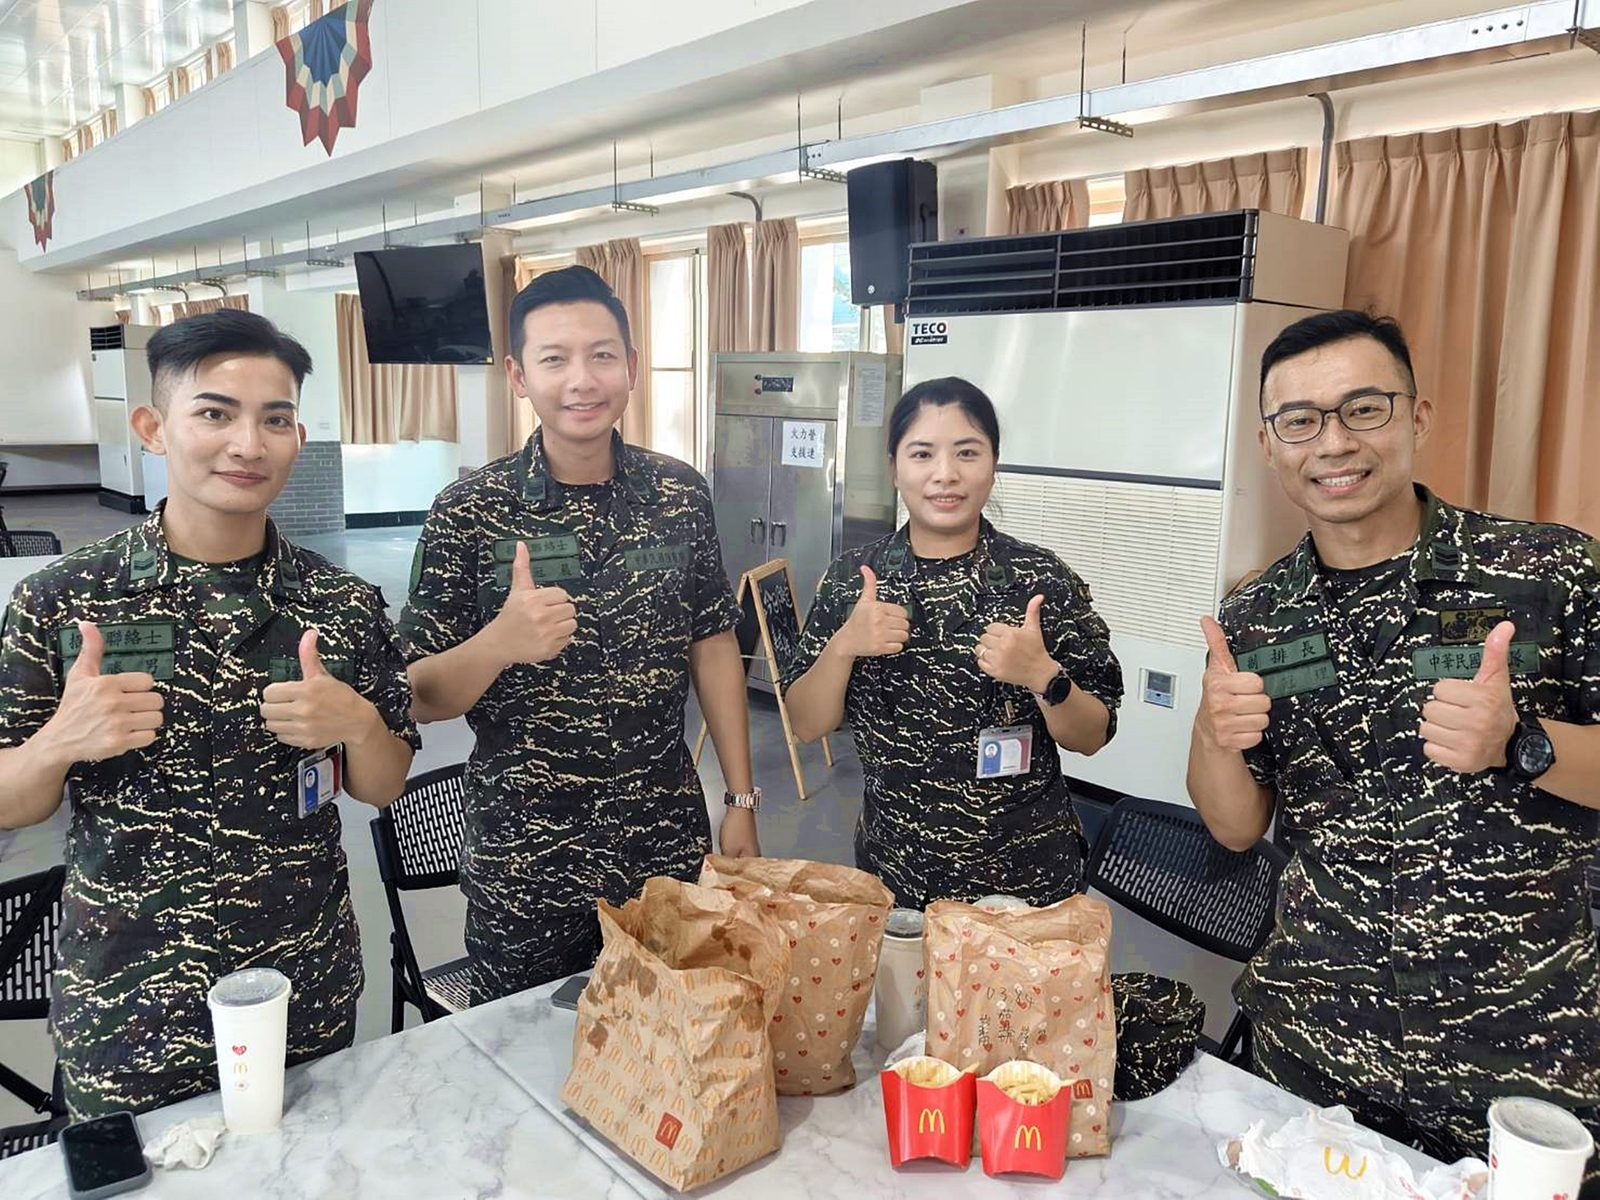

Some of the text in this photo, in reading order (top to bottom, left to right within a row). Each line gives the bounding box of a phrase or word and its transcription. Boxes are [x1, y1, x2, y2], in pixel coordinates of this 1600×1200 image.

[912, 322, 947, 335] TECO
[68, 628, 163, 650] 招聯絡士
[1247, 640, 1316, 670] 副排長
[919, 1108, 945, 1134] M
[1014, 1125, 1041, 1151] M
